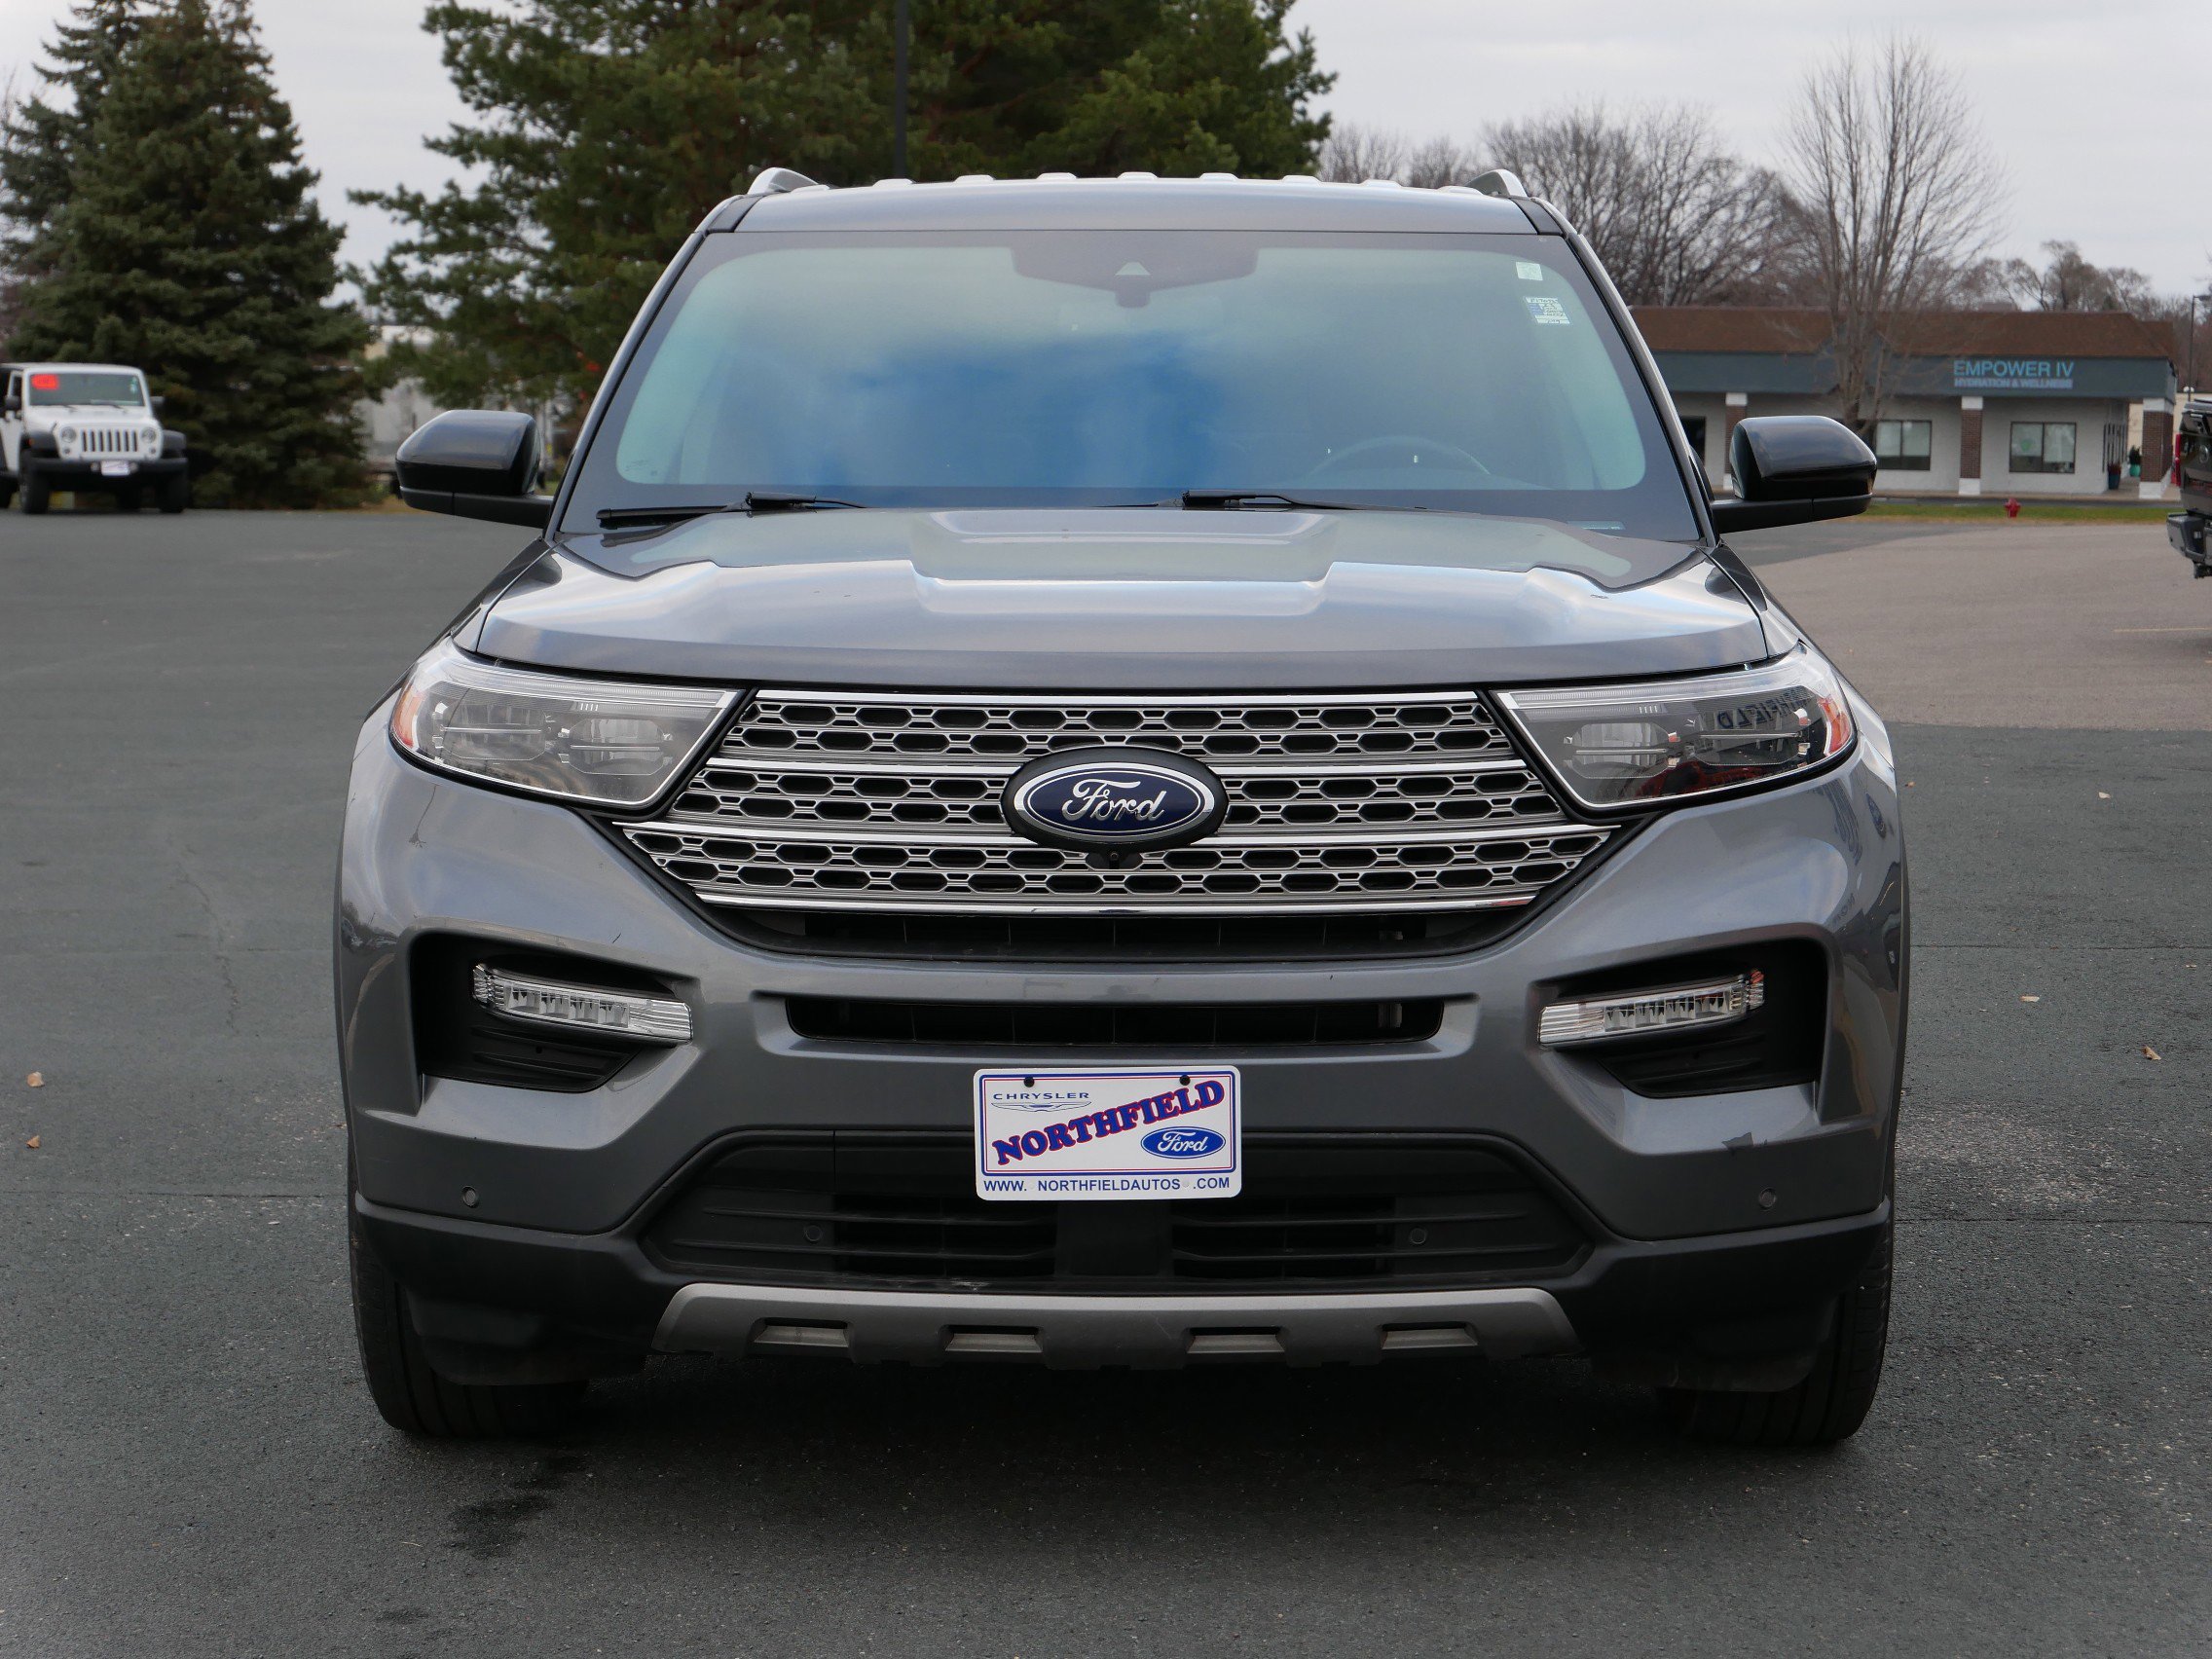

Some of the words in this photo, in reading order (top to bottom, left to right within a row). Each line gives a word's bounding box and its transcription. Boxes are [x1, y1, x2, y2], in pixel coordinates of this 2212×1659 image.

[1953, 360, 2050, 378] EMPOWER
[2056, 360, 2075, 378] IV
[1954, 378, 2009, 387] HYDRATION
[1061, 778, 1168, 822] Ford
[991, 1080, 1226, 1166] NORTHFIELD
[1157, 1132, 1209, 1153] Ford
[983, 1180, 1027, 1193] WWW.
[1037, 1177, 1181, 1193] NORTHFIELDAUTOS
